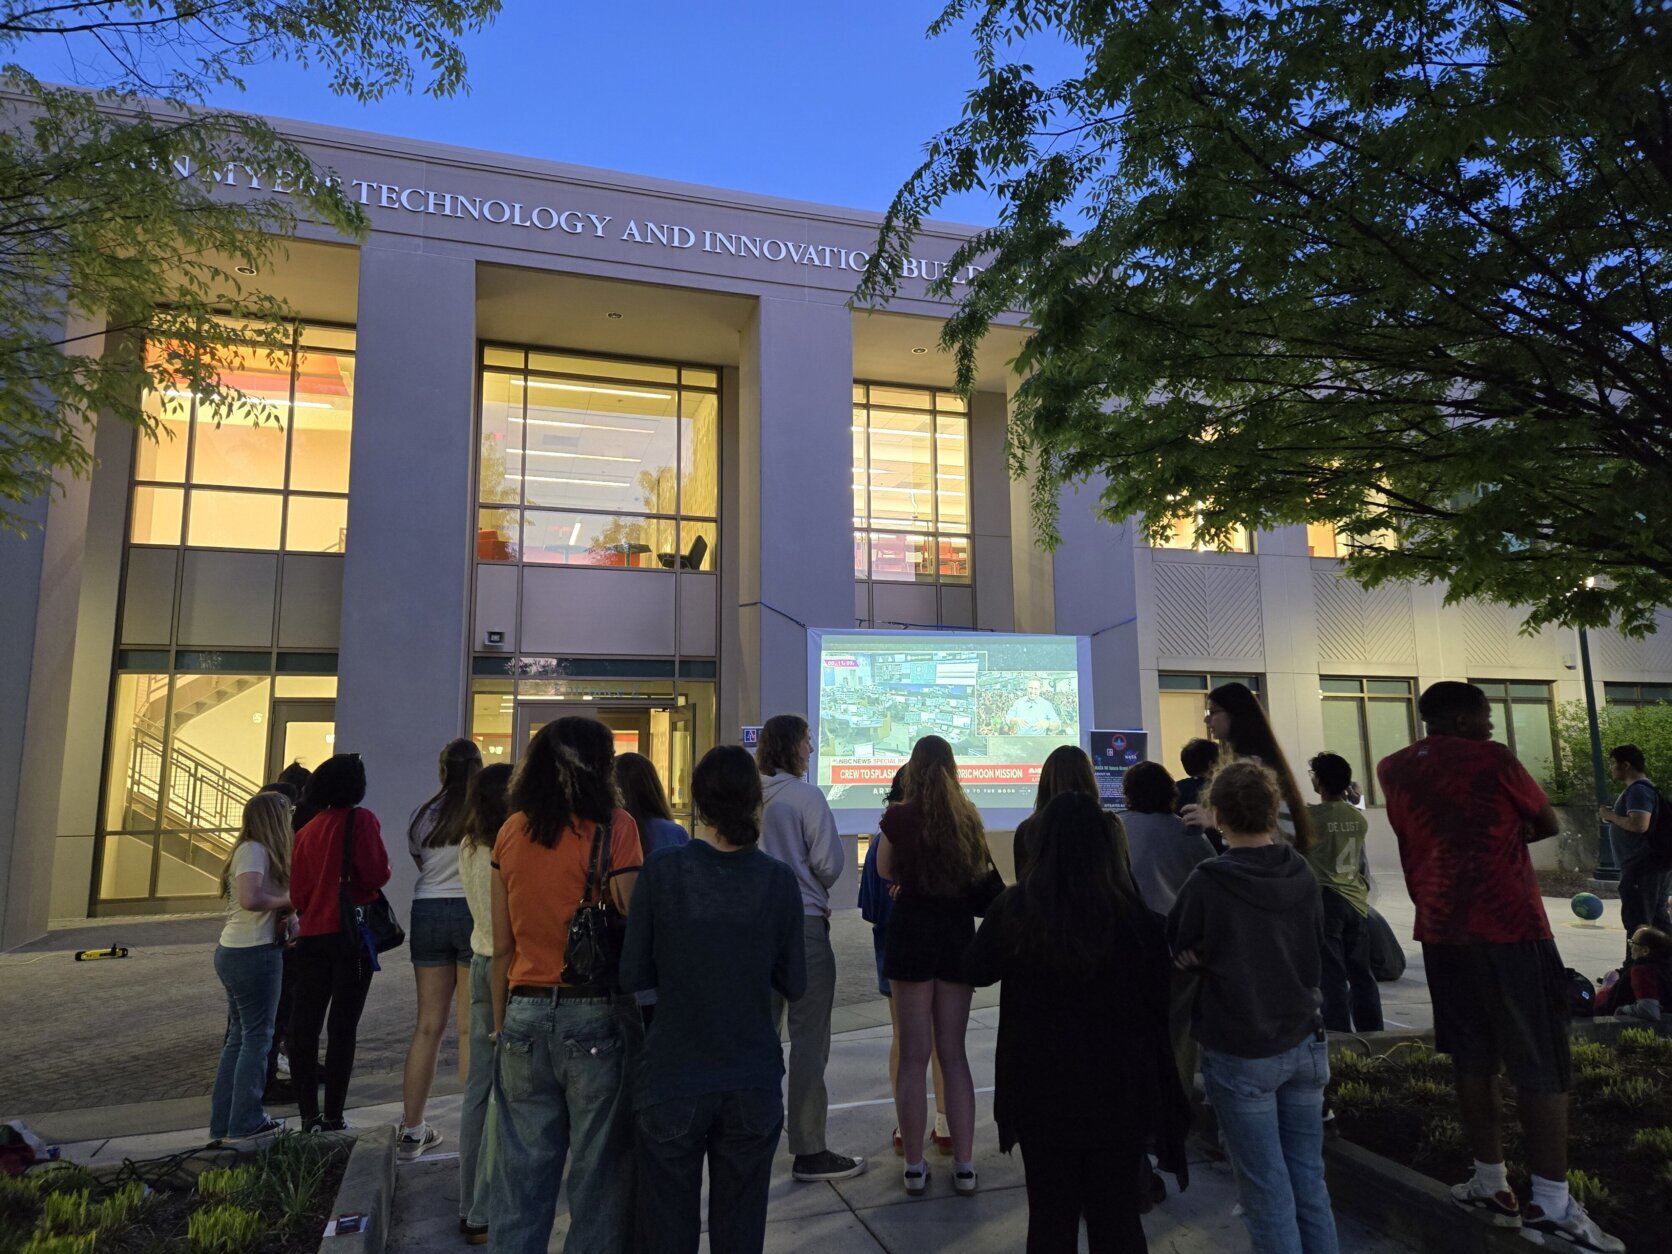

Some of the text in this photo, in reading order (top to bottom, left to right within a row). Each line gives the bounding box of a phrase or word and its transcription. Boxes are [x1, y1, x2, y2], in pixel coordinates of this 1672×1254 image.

[352, 178, 612, 238] TECHNOLOGY
[621, 218, 695, 249] AND
[840, 770, 860, 779] CREW
[861, 770, 871, 778] TO
[973, 768, 994, 778] MOON
[995, 768, 1022, 778] MISSION
[1328, 822, 1359, 832] DE LIGT
[1336, 837, 1356, 880] 4
